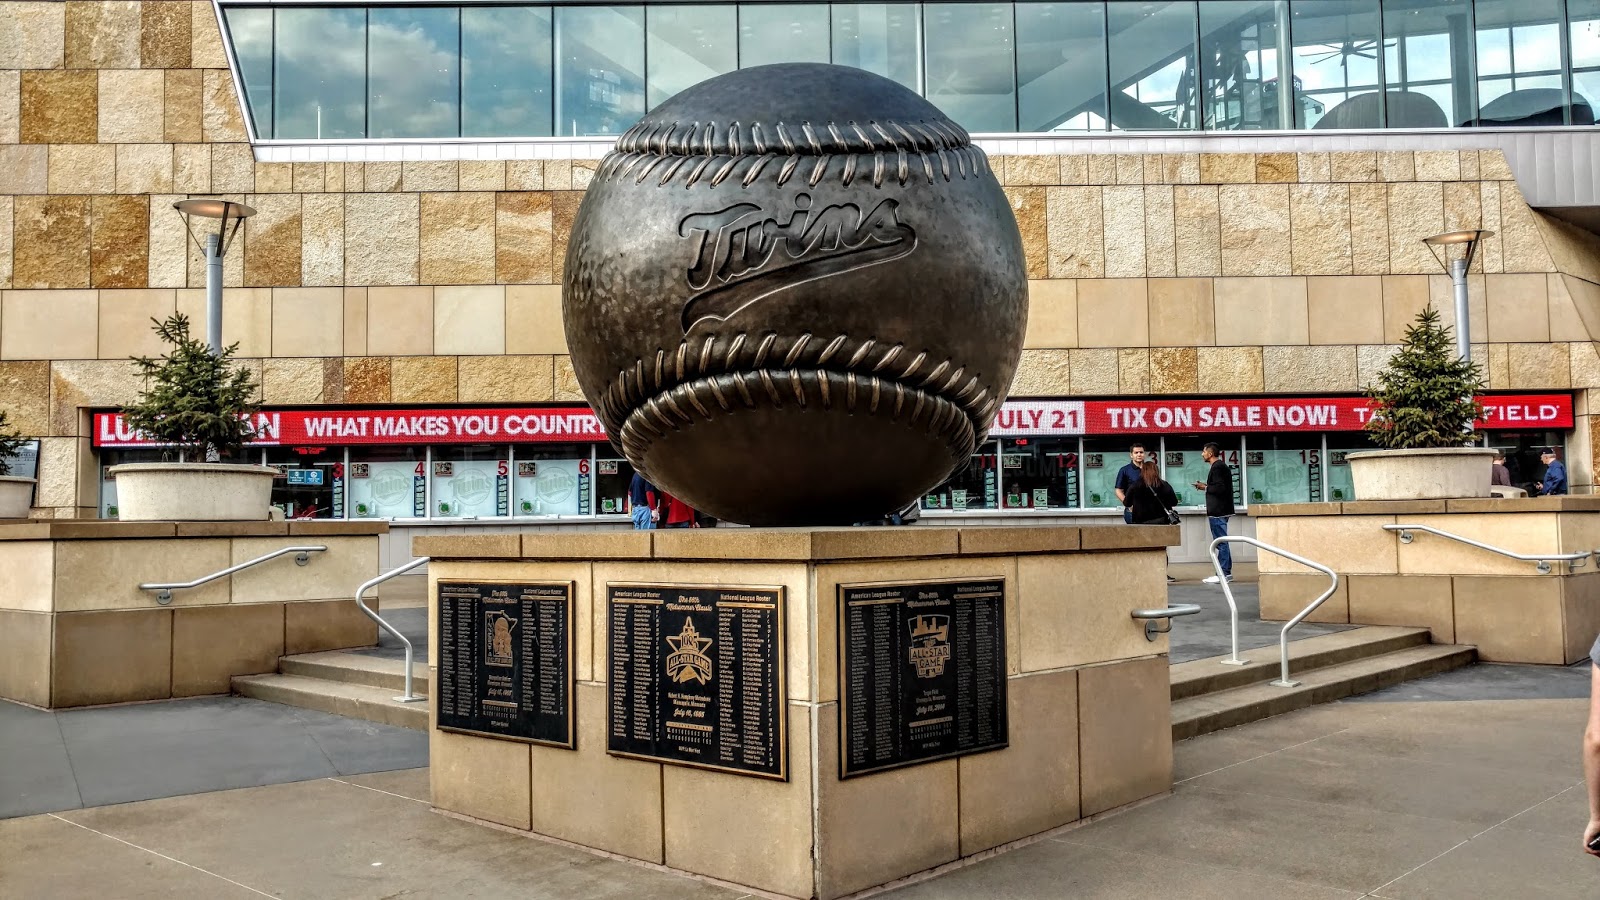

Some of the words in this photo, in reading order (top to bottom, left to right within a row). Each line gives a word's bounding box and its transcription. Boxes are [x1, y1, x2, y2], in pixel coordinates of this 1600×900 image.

[679, 193, 917, 290] Twins
[990, 410, 1043, 429] ULY
[1051, 410, 1078, 429] 21
[1107, 407, 1148, 428] TIX
[1154, 407, 1192, 428] ON
[1199, 406, 1261, 428] SALE
[1267, 405, 1338, 426] NOW!
[1483, 405, 1558, 421] FIELD
[304, 417, 370, 437] WHAT
[373, 416, 449, 436] MAKES
[451, 415, 499, 436] YOU
[979, 453, 997, 468] 11
[1056, 453, 1077, 468] 12
[1218, 450, 1239, 465] 14
[1299, 449, 1320, 465] 15
[332, 462, 344, 478] 3
[415, 461, 425, 476] 4
[497, 460, 508, 475] 5
[579, 458, 590, 474] 6
[739, 594, 756, 602] League
[871, 591, 887, 599] League
[929, 647, 948, 657] STAR
[693, 655, 710, 672] GAME
[919, 657, 941, 668] GAME
[673, 708, 685, 718] July
